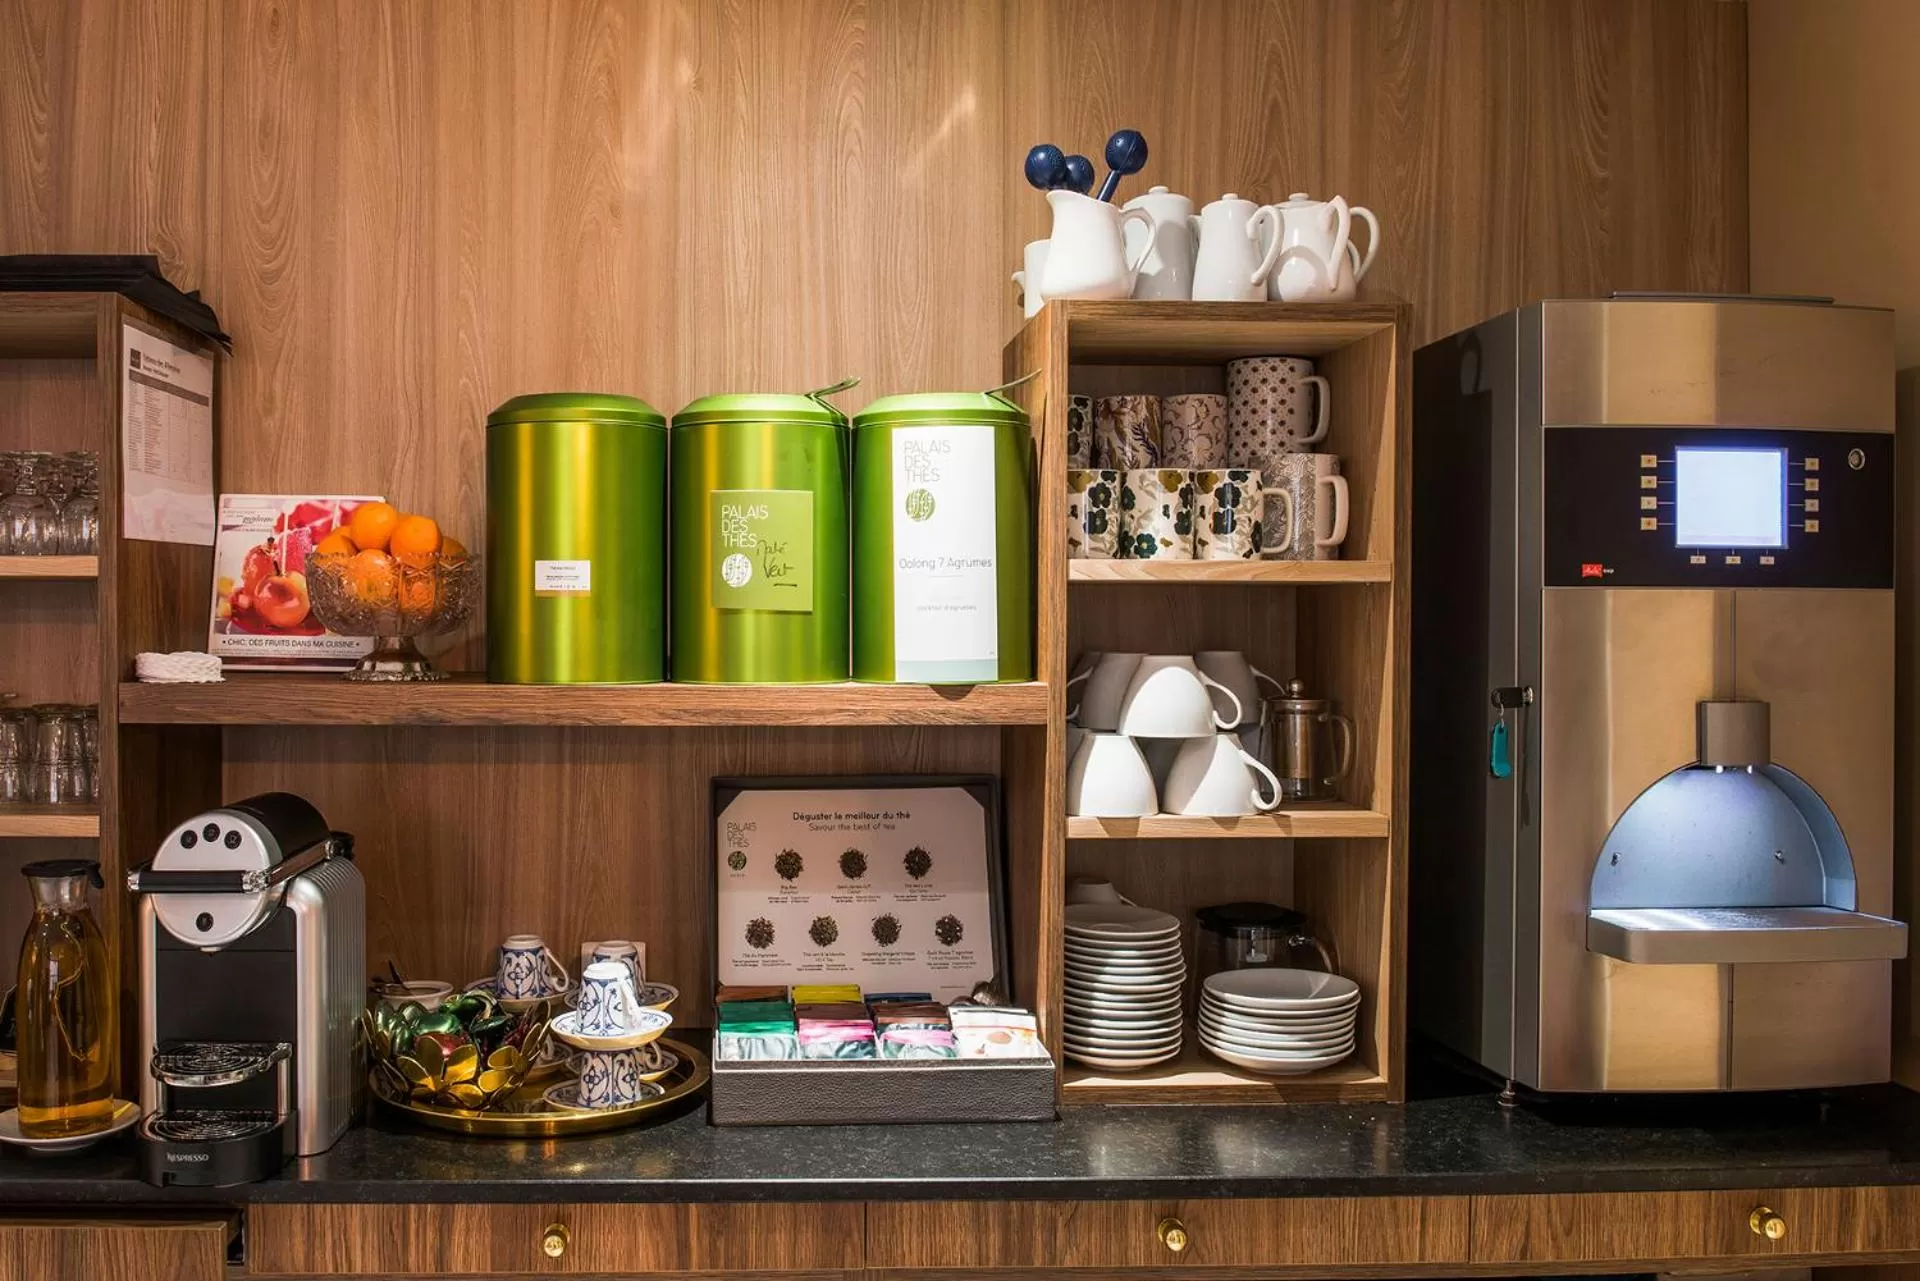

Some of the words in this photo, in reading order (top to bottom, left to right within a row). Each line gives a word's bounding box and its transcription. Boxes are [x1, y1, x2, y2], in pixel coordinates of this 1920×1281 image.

[903, 440, 951, 454] PALAIS
[903, 454, 931, 468] DES
[721, 504, 769, 520] PALAIS
[721, 519, 749, 533] DES
[939, 557, 945, 568] 7
[947, 557, 993, 570] Agrumes
[291, 640, 312, 648] DANS
[312, 640, 325, 648] MA
[834, 812, 843, 820] le
[882, 811, 894, 820] du
[166, 1152, 209, 1162] NESPRESSO
